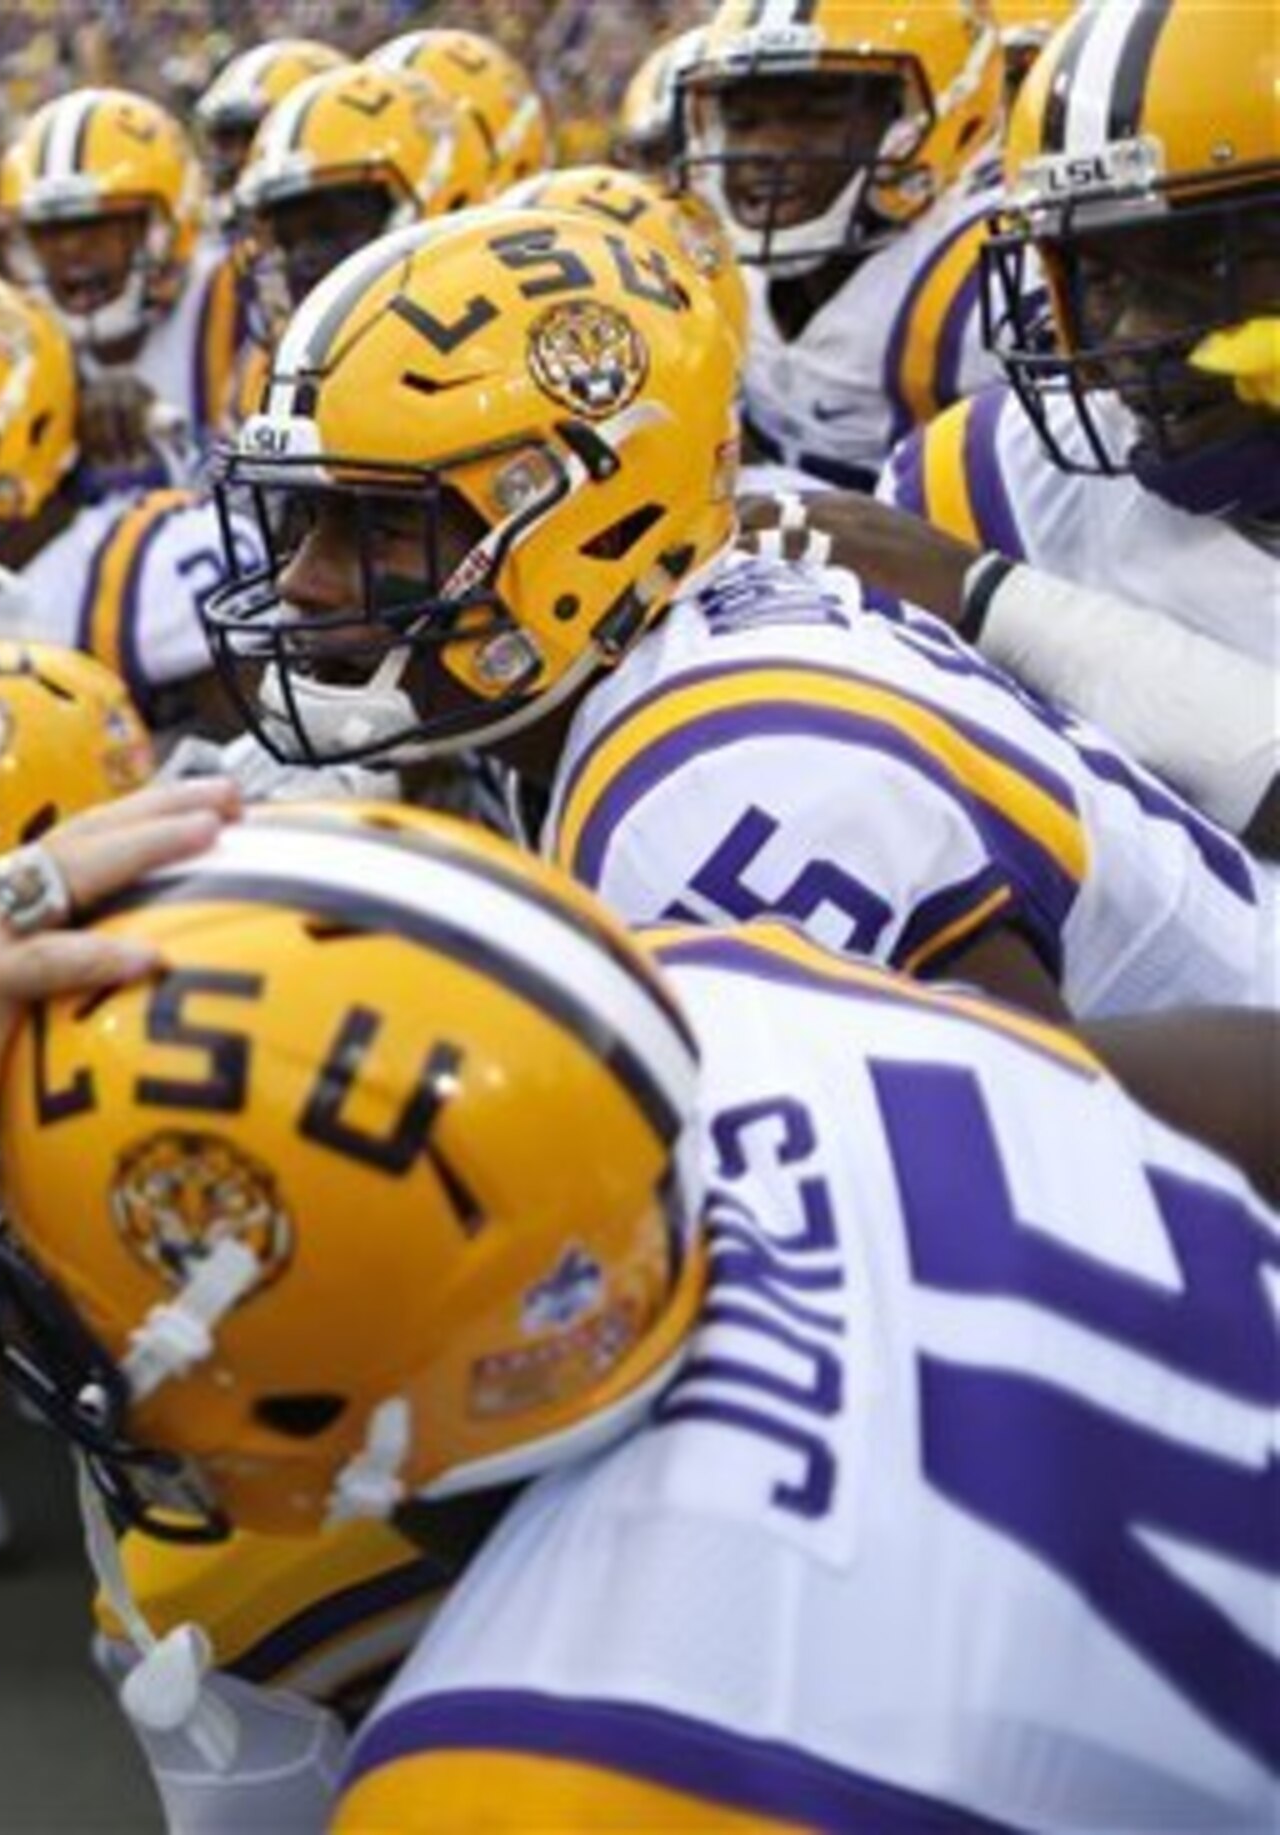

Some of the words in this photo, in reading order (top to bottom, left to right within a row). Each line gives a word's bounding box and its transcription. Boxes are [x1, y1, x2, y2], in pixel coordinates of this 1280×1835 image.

[387, 228, 683, 354] LSU
[29, 966, 464, 1178] LSU
[651, 1096, 846, 1521] JONES
